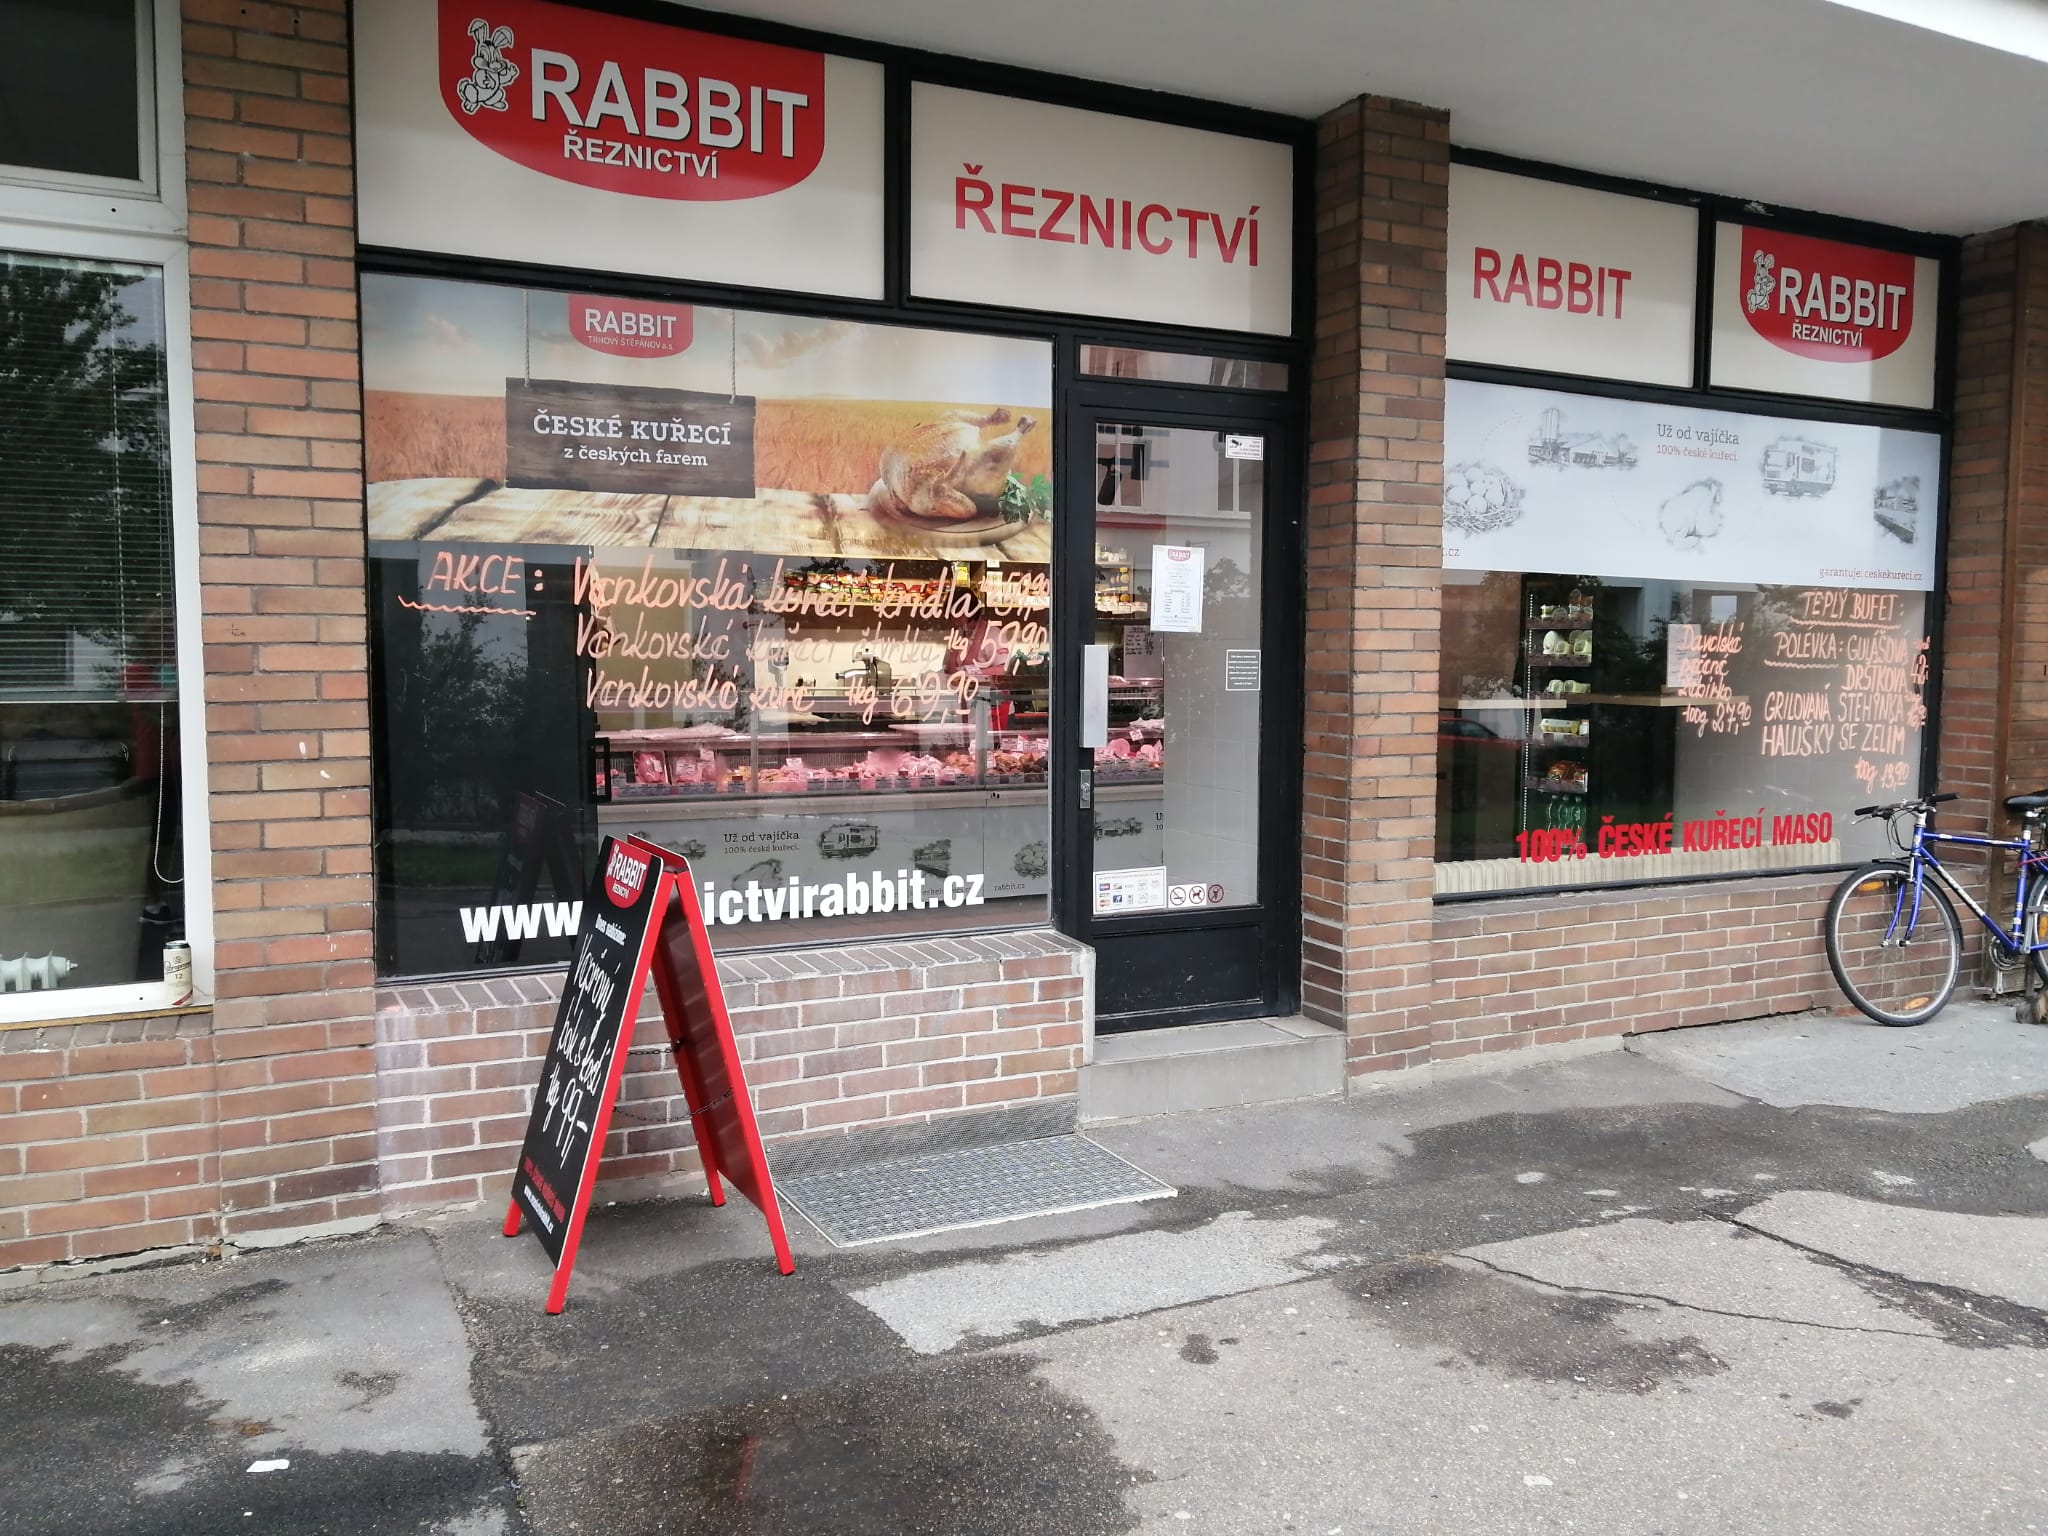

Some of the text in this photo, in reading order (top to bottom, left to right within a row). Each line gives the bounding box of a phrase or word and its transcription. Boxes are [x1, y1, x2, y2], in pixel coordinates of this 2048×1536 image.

[530, 47, 809, 159] RABBIT
[563, 129, 718, 180] ŘEZNICTVÍ
[955, 163, 1260, 266] ŘEZNICTVÍ
[1473, 247, 1631, 319] RABBIT
[1778, 267, 1907, 332] RABBIT
[585, 308, 677, 338] RABBIT
[588, 335, 619, 346] TRHOVÝ
[620, 337, 660, 349] ŠTĚPÁNOV
[1792, 319, 1864, 348] ŘEZNICTVÍ
[533, 408, 731, 446] ČESKÉ KUŘECÍ
[1656, 423, 1740, 447] Už od vajíčka
[563, 445, 709, 466] z českých farem
[1656, 445, 1682, 455] 100%
[1799, 588, 1849, 619] TEPLÝ
[1764, 683, 1832, 722] GRILOVANÁ
[1761, 718, 1906, 757] HALUŠKY SE ZELÍM
[723, 829, 800, 843] Už od vajíčka
[1516, 807, 1833, 863] 100% ČESKÉ KUŘECÍ MASO
[612, 852, 647, 891] RABBIT
